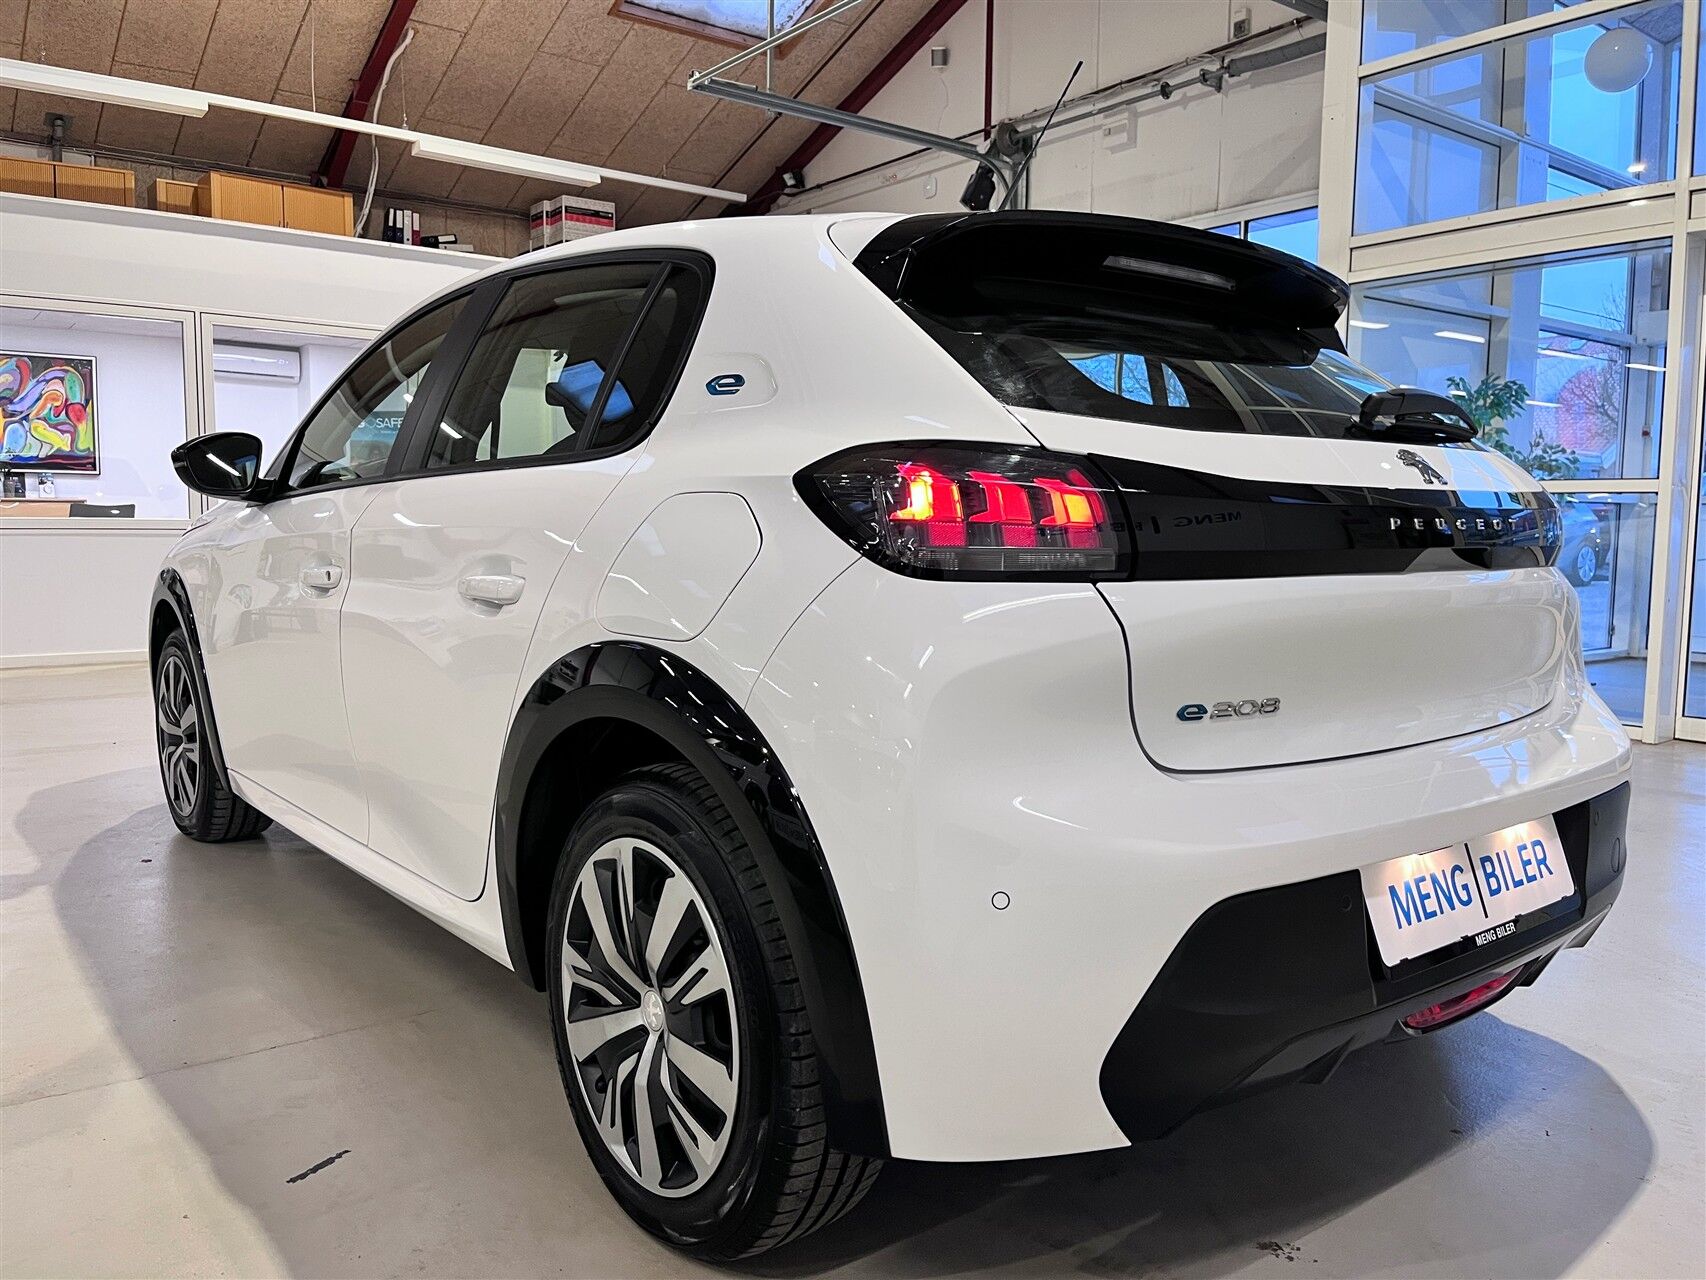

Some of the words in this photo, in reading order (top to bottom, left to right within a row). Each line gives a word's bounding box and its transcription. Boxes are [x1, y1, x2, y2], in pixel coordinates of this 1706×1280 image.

[1389, 516, 1520, 531] PEUGEOT
[1388, 863, 1473, 930] MENG
[1479, 838, 1554, 897] BILER
[1475, 929, 1497, 947] MENG
[1495, 922, 1516, 939] BILER
